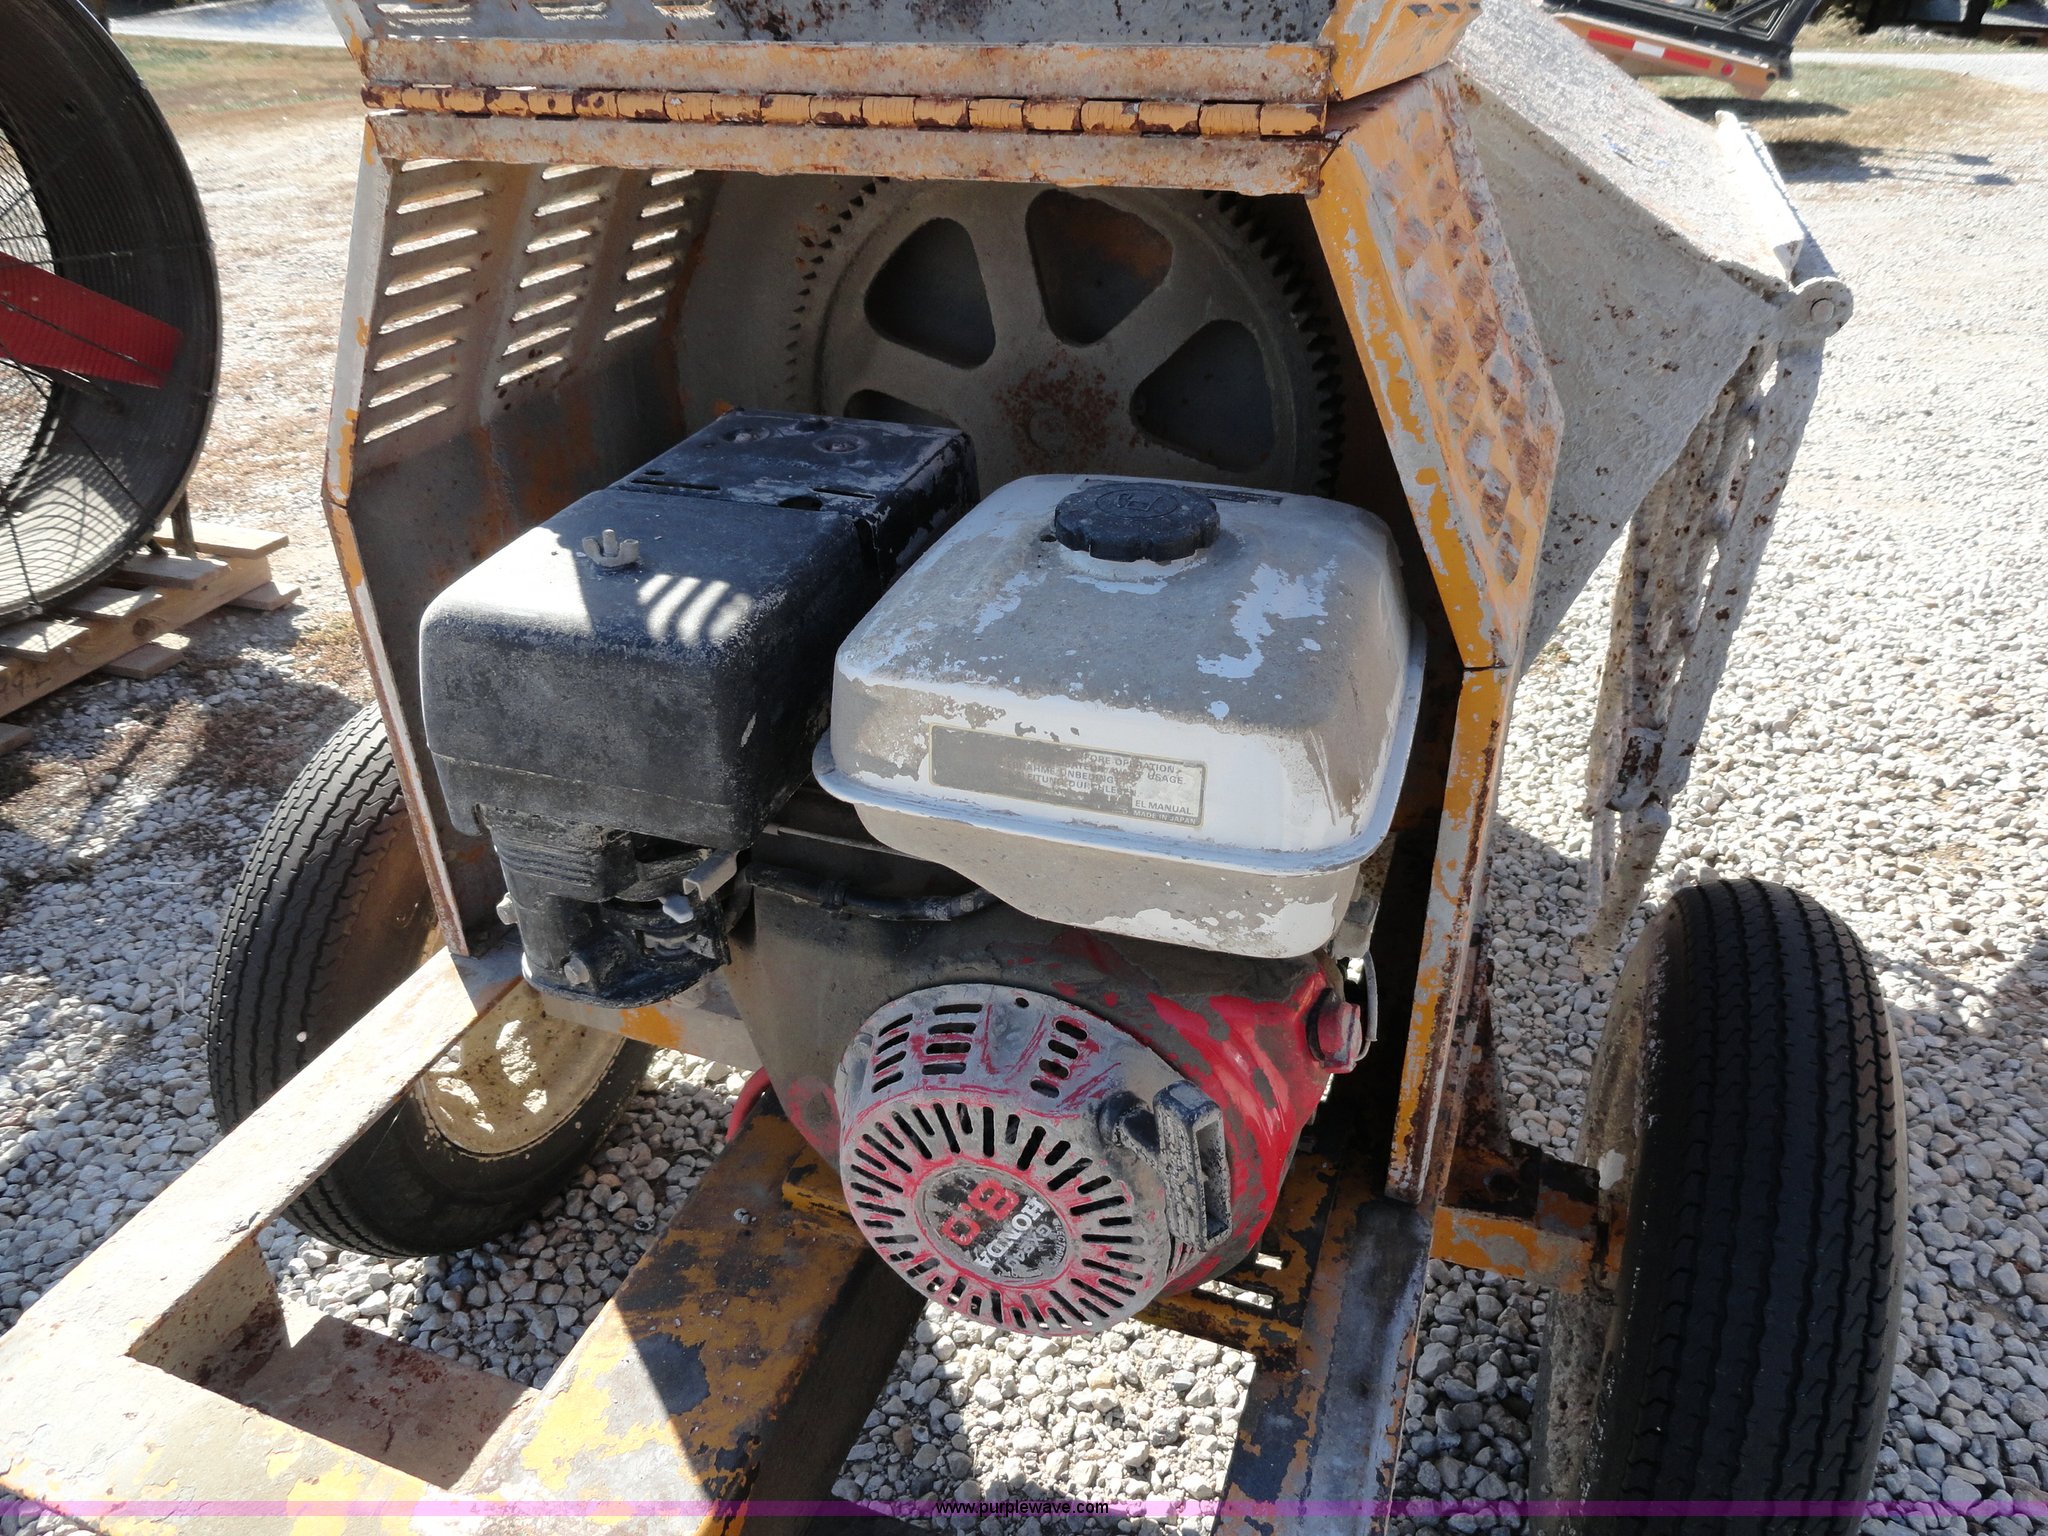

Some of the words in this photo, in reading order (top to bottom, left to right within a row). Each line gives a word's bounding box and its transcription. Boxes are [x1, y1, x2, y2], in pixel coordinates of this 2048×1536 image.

[1133, 810, 1155, 820] MADE
[1157, 813, 1167, 821] IN
[1169, 814, 1196, 824] JAPAN
[975, 1196, 1046, 1270] HONDA
